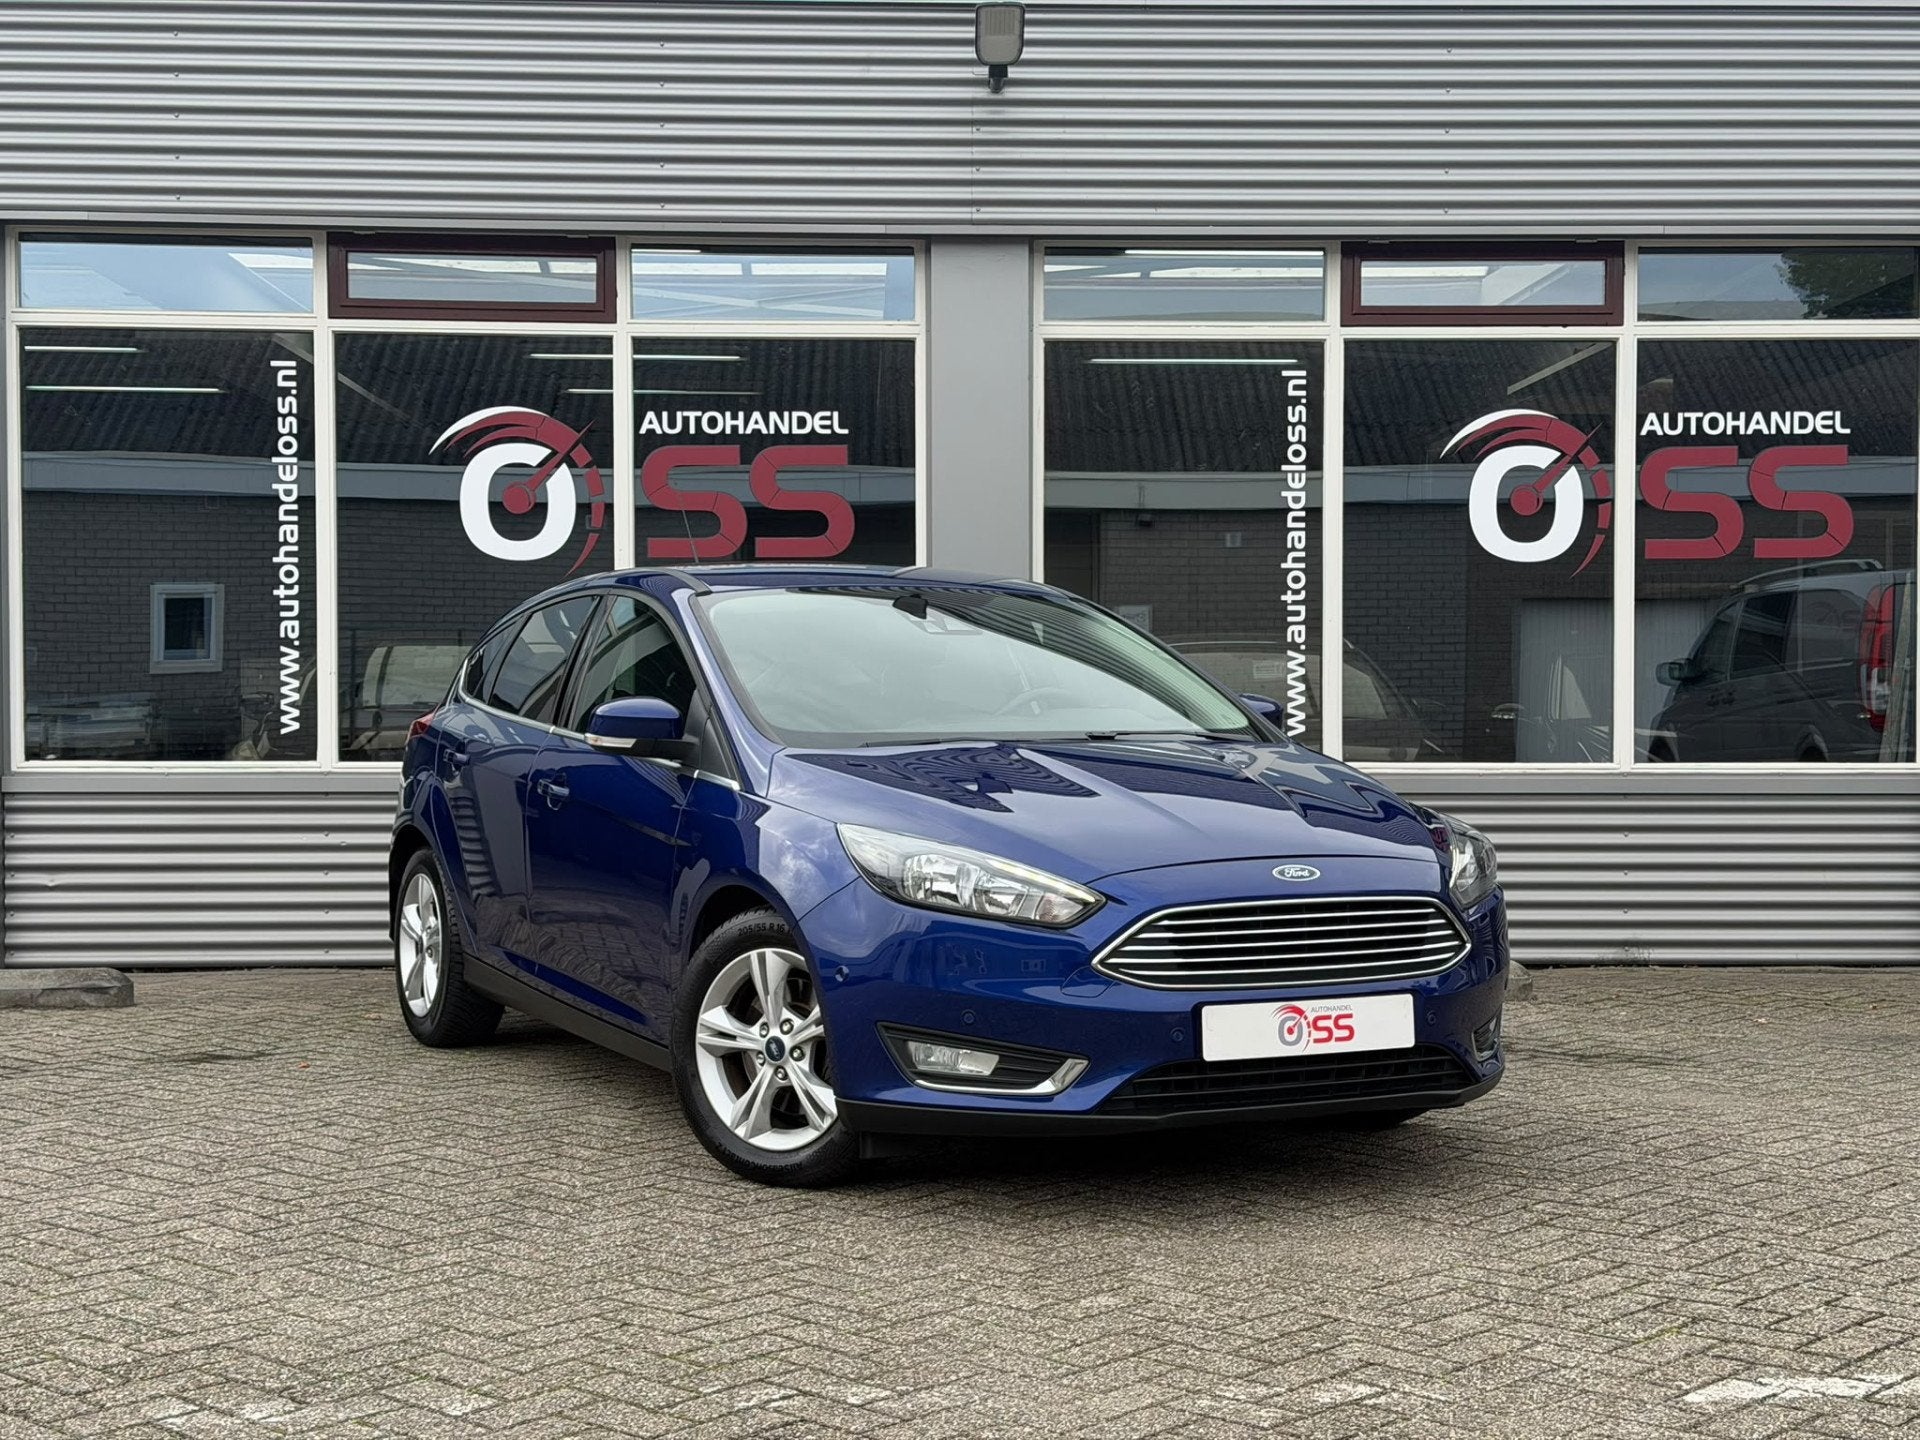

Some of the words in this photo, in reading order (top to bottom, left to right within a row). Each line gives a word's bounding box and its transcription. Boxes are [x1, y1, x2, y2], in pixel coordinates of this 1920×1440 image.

[639, 410, 849, 435] AUTOHANDEL
[1640, 410, 1851, 436] AUTOHANDEL
[270, 360, 300, 735] www.autohandeloss.nl
[1281, 369, 1308, 737] www.autohandeloss.nl
[1283, 867, 1310, 878] Ford
[1310, 1004, 1353, 1013] AUTOHANDEL
